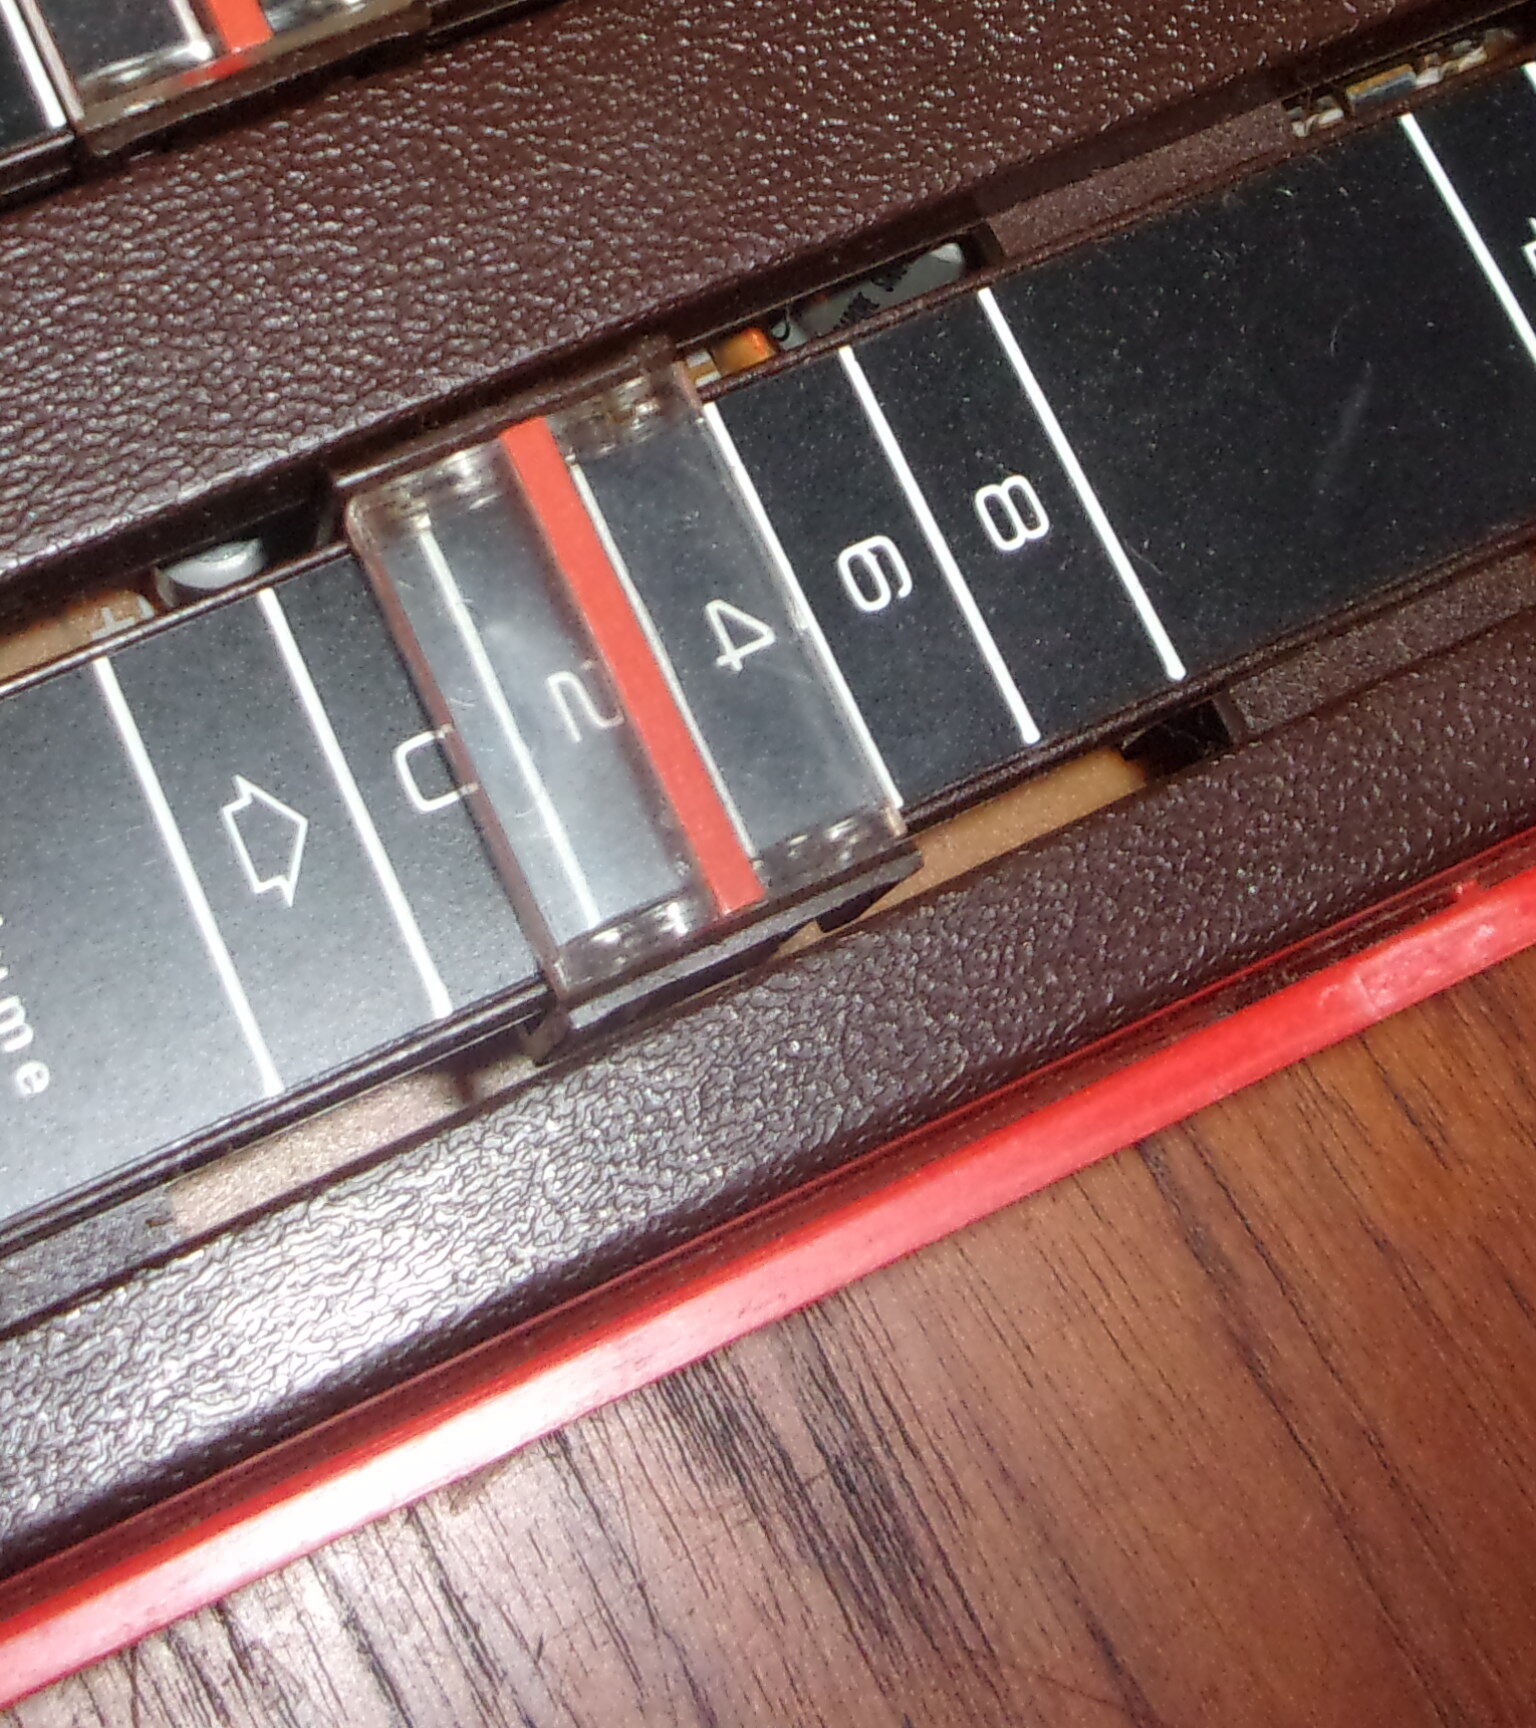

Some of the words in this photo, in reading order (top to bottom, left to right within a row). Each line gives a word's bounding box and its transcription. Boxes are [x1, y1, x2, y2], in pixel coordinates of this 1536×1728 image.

[972, 472, 1052, 554] 8
[835, 532, 915, 616] 6
[703, 597, 779, 674] 4
